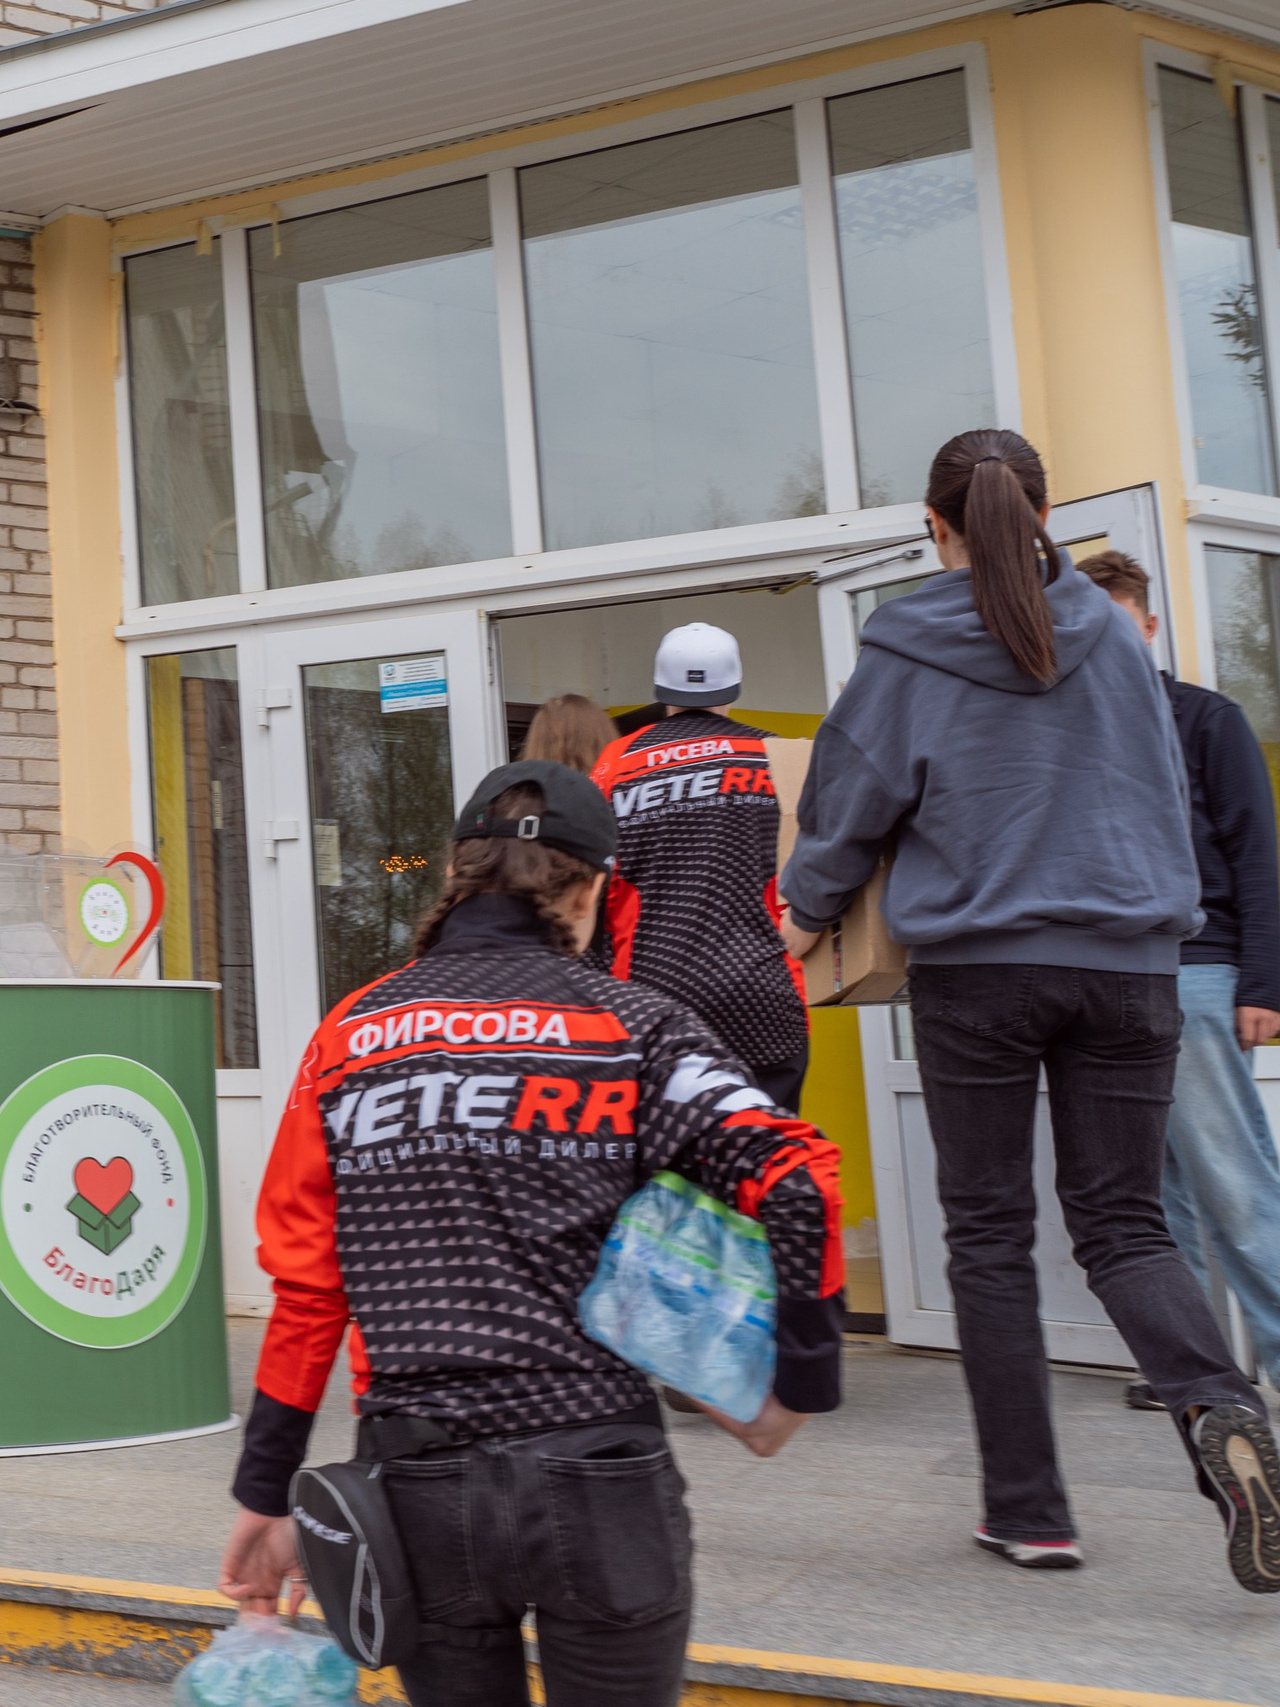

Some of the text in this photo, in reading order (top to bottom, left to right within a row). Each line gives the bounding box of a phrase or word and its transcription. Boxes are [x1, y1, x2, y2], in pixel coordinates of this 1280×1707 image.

[647, 740, 735, 767] ГУСЕВА
[612, 767, 776, 818] VETERR
[348, 1009, 571, 1058] ФИРСОВА
[325, 1071, 639, 1147] VETERR
[23, 1103, 174, 1185] БЛАГОТВОРИТЕЛЬНЫЙ ФОНД
[335, 1132, 638, 1174] ФИЦИАЛЬНЫЙ ДИЛЕР
[42, 1245, 167, 1300] БлагоДаря
